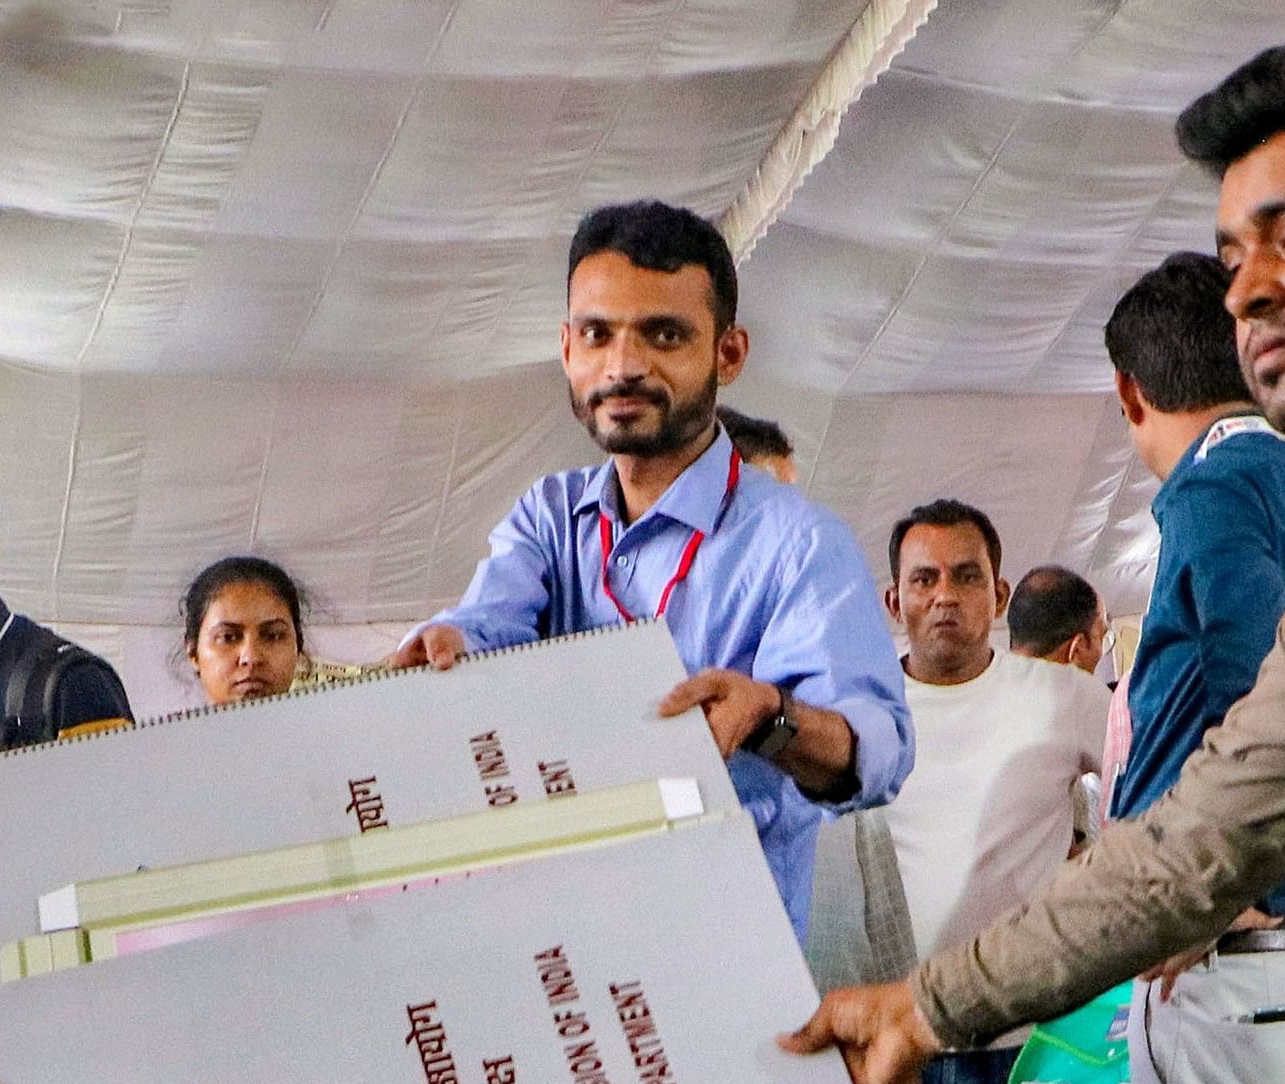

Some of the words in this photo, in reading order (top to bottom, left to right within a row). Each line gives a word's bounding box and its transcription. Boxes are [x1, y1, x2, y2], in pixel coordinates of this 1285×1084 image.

[469, 729, 512, 782] INDIA
[484, 786, 519, 810] OF
[534, 945, 580, 1006] INDIA
[554, 1010, 591, 1037] OF
